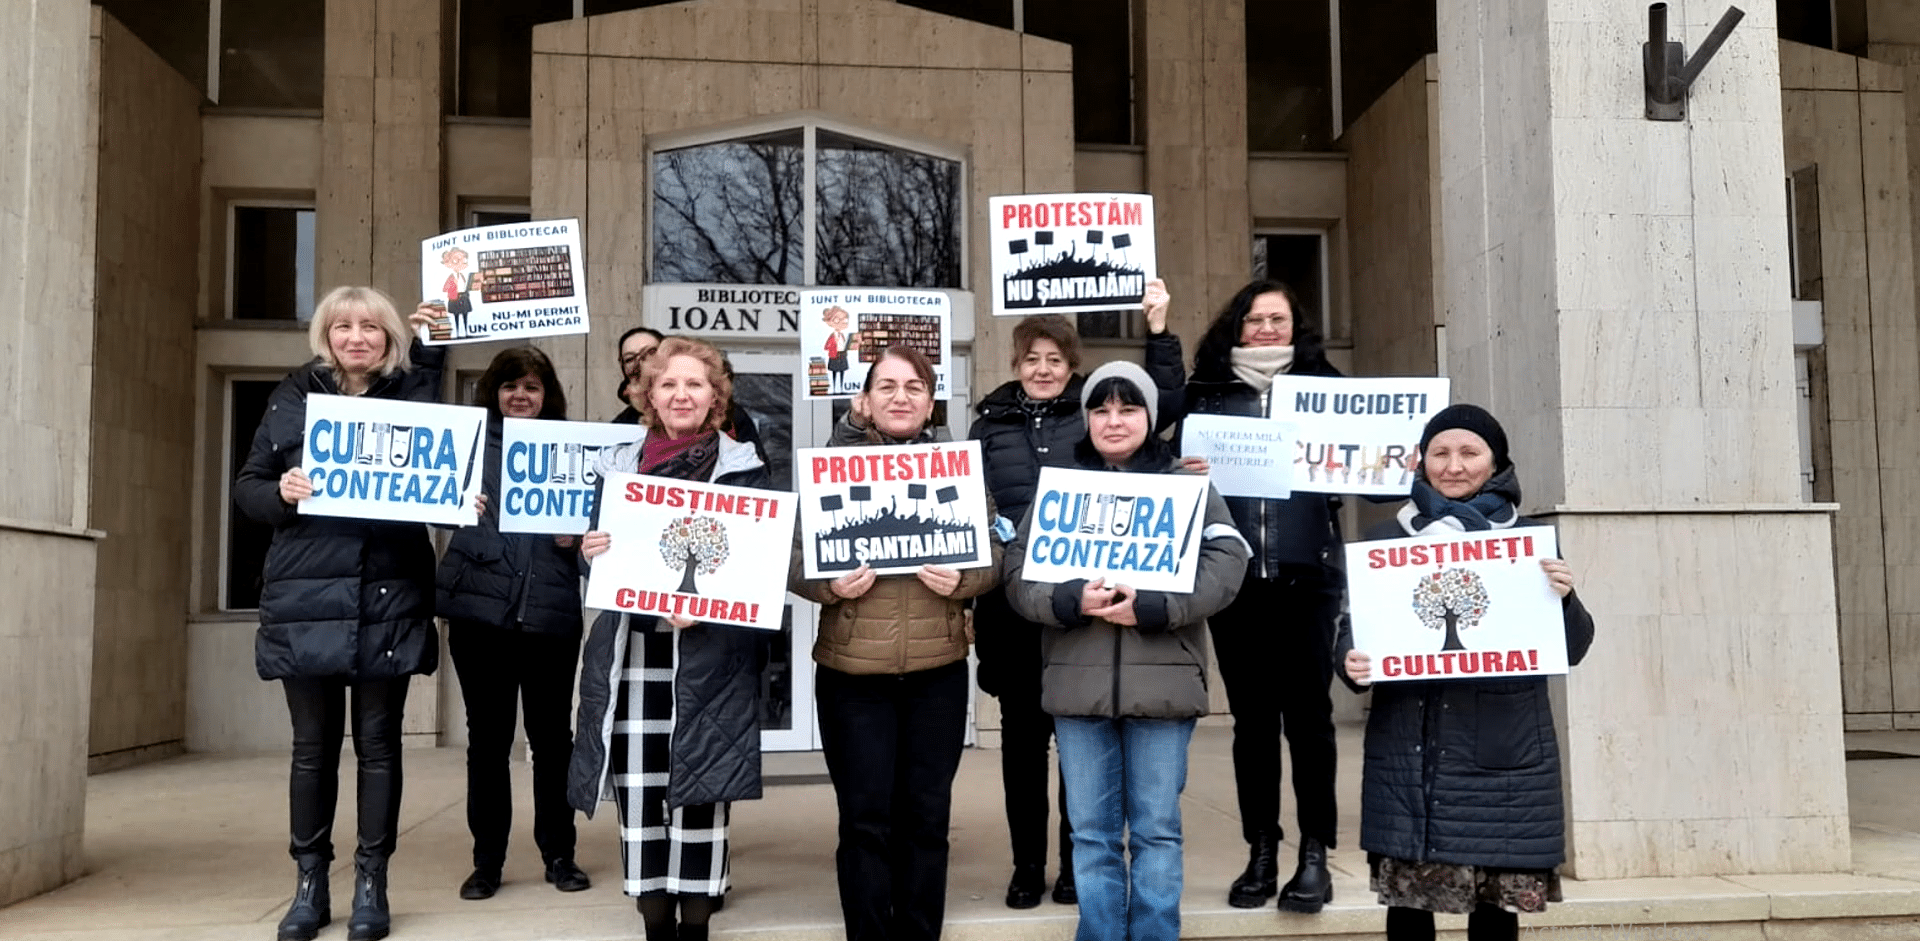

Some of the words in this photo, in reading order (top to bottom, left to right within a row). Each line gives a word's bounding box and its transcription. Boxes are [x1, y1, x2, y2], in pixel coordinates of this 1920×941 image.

[1002, 197, 1143, 229] PROTESTĂM
[432, 237, 457, 251] SUNT
[463, 233, 481, 242] UN
[486, 225, 568, 240] BIBLIOTECAR
[697, 289, 800, 304] BIBLIOTEC
[811, 295, 839, 304] SUNT
[845, 294, 861, 303] UN
[867, 294, 942, 306] BIBLIOTECAR
[1006, 279, 1034, 301] NU
[468, 324, 487, 334] UN
[491, 320, 525, 331] CONT
[529, 317, 581, 328] BANCAR
[492, 310, 531, 321] NU-MI
[534, 306, 580, 317] PERMIT
[668, 307, 761, 331] IOAN
[843, 382, 860, 391] UN
[1295, 392, 1327, 413] NU
[1333, 393, 1428, 420] UCIDEȚI
[309, 418, 458, 471] CULTURA
[507, 441, 603, 486] CULTU
[812, 446, 971, 484] PROTESTĂM
[308, 467, 458, 506] CONTEAZĂ
[505, 487, 596, 517] CONTE
[624, 481, 779, 523] SUSȚINEȚI
[1038, 490, 1175, 539] CULTURA
[820, 538, 850, 563] NU
[1032, 535, 1174, 573] CONTEAZĂ
[1368, 535, 1534, 570] SUSȚINEȚI
[615, 587, 760, 623] CULTURA!
[1382, 649, 1539, 677] CULTURA!
